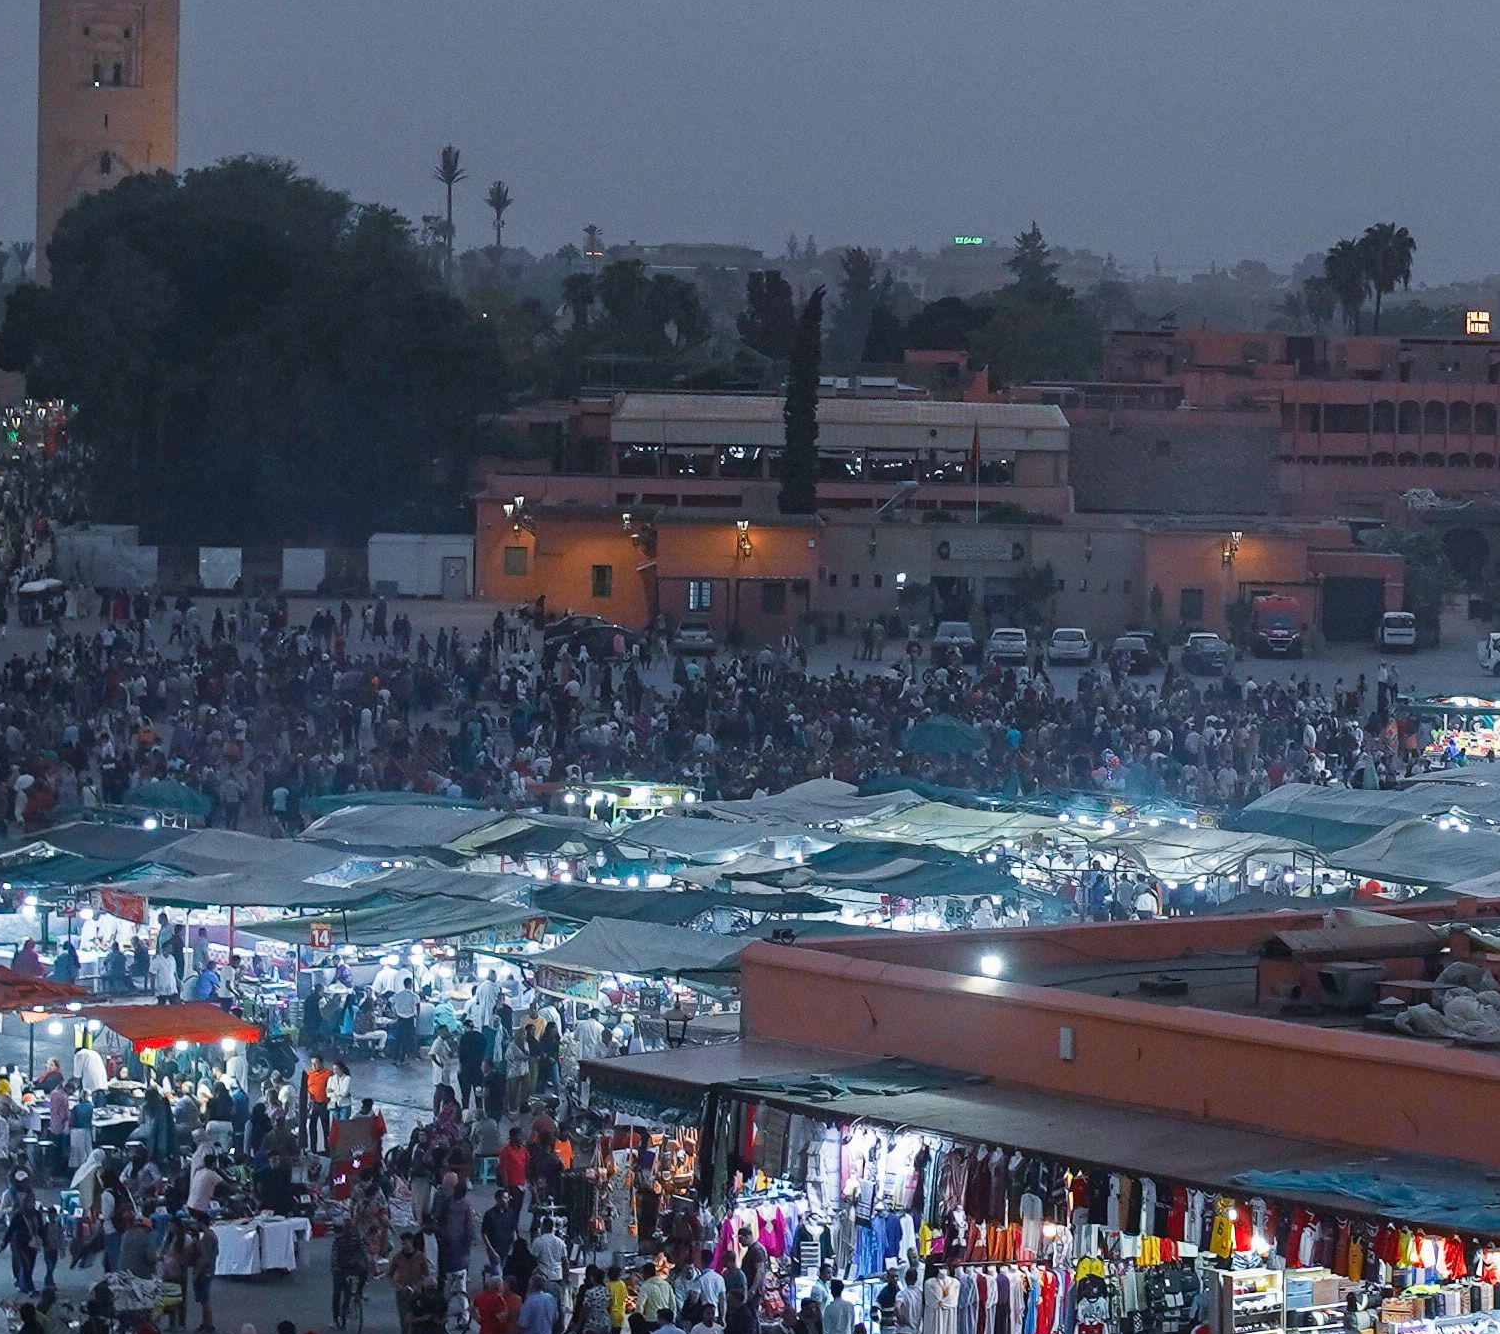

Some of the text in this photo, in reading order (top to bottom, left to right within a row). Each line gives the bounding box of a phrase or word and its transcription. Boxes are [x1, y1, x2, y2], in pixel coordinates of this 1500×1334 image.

[57, 899, 76, 913] 59
[947, 906, 964, 918] 35
[311, 929, 330, 947] 14
[643, 997, 656, 1007] 05
